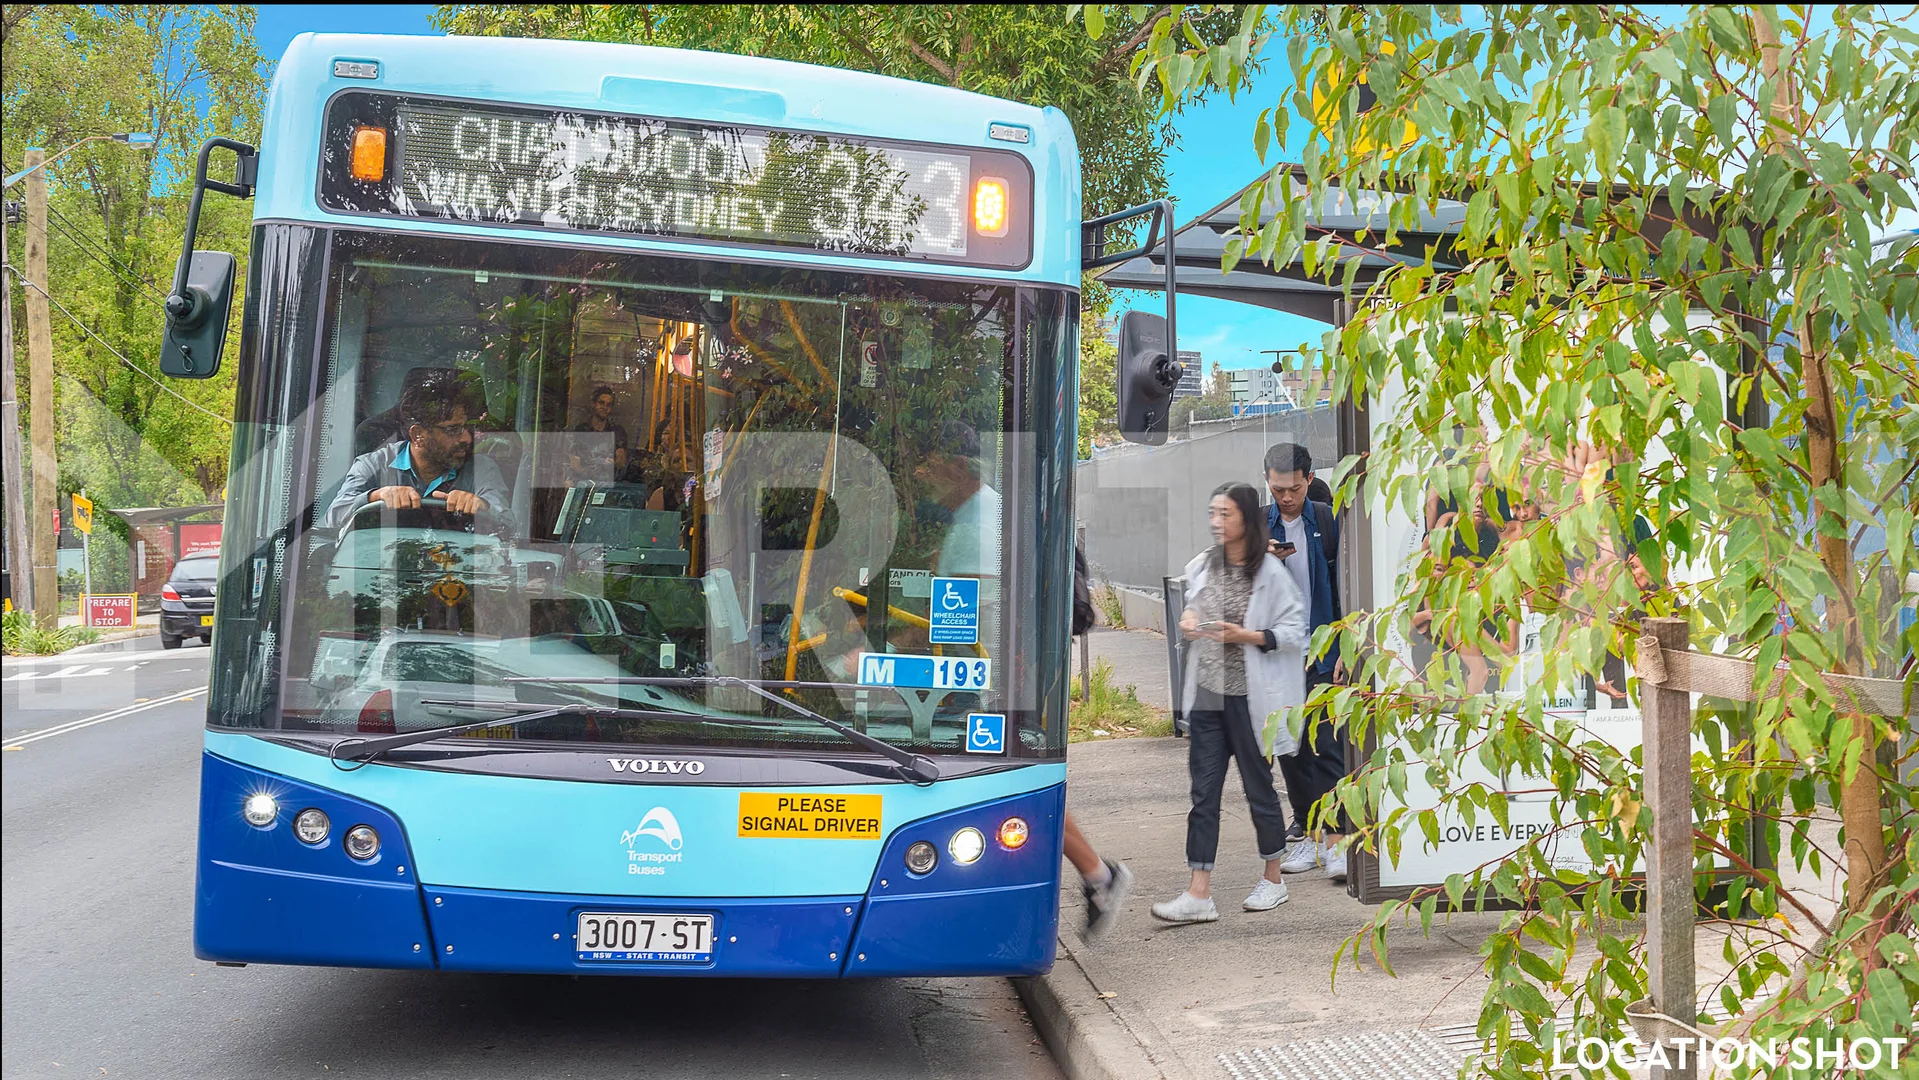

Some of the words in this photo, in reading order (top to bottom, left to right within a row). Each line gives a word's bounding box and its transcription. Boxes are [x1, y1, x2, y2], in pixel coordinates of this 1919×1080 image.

[813, 149, 963, 248] 343
[102, 608, 114, 617] TO
[933, 612, 976, 620] WHEELCHAIR
[95, 617, 122, 626] STOP
[865, 658, 895, 684] M
[940, 660, 986, 687] 193
[607, 758, 705, 775] VOLVO
[778, 798, 846, 813] PLEASE
[742, 816, 809, 831] SIGNAL
[814, 818, 879, 833] DRIVER
[1438, 826, 1485, 843] LOVE
[627, 850, 683, 863] Transport
[628, 864, 666, 875] Buses
